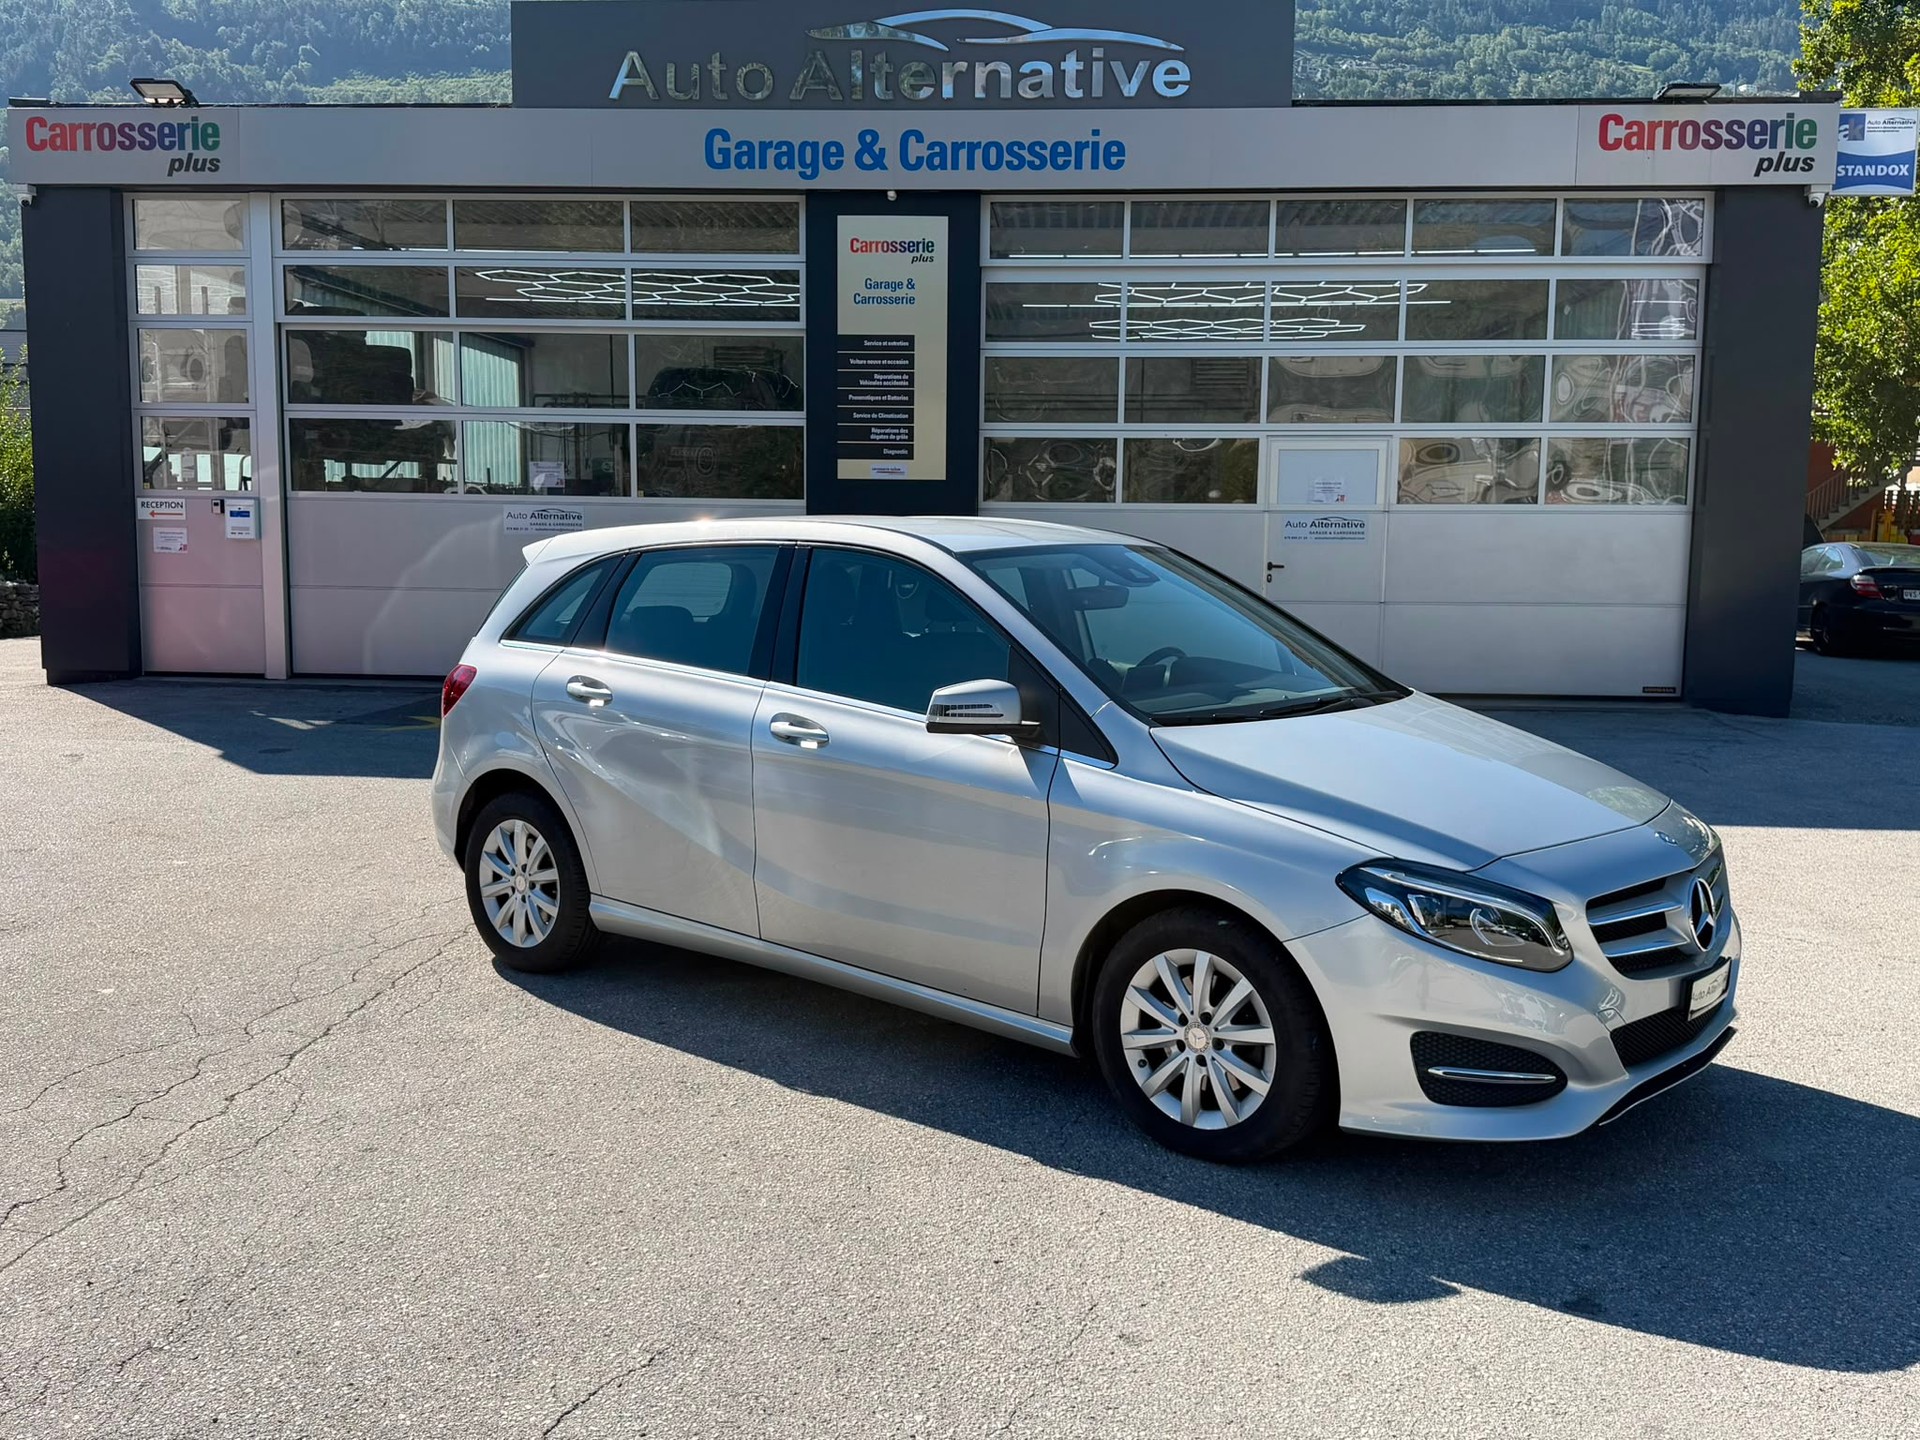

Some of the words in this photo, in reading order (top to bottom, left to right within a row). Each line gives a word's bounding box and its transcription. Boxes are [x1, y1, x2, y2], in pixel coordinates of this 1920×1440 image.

[608, 50, 775, 101] Auto
[789, 47, 1191, 101] Alternative
[25, 115, 221, 152] Carrosserie
[1598, 112, 1818, 151] Carrosserie
[704, 128, 845, 180] Garage
[854, 128, 889, 171] &
[899, 128, 1126, 171] Carrosserie
[167, 152, 221, 177] plus
[1753, 151, 1816, 177] plus
[1837, 165, 1909, 177] STANDOX
[850, 237, 935, 254] Carrosserie
[911, 253, 935, 264] plus
[864, 277, 904, 292] Garage
[906, 277, 916, 290] &
[853, 292, 916, 305] Carrosserie
[140, 500, 184, 509] RECEPTION
[506, 511, 528, 520] Auto
[529, 512, 583, 520] Alternative
[1284, 520, 1308, 528] Auto
[1309, 520, 1365, 528] Alternative
